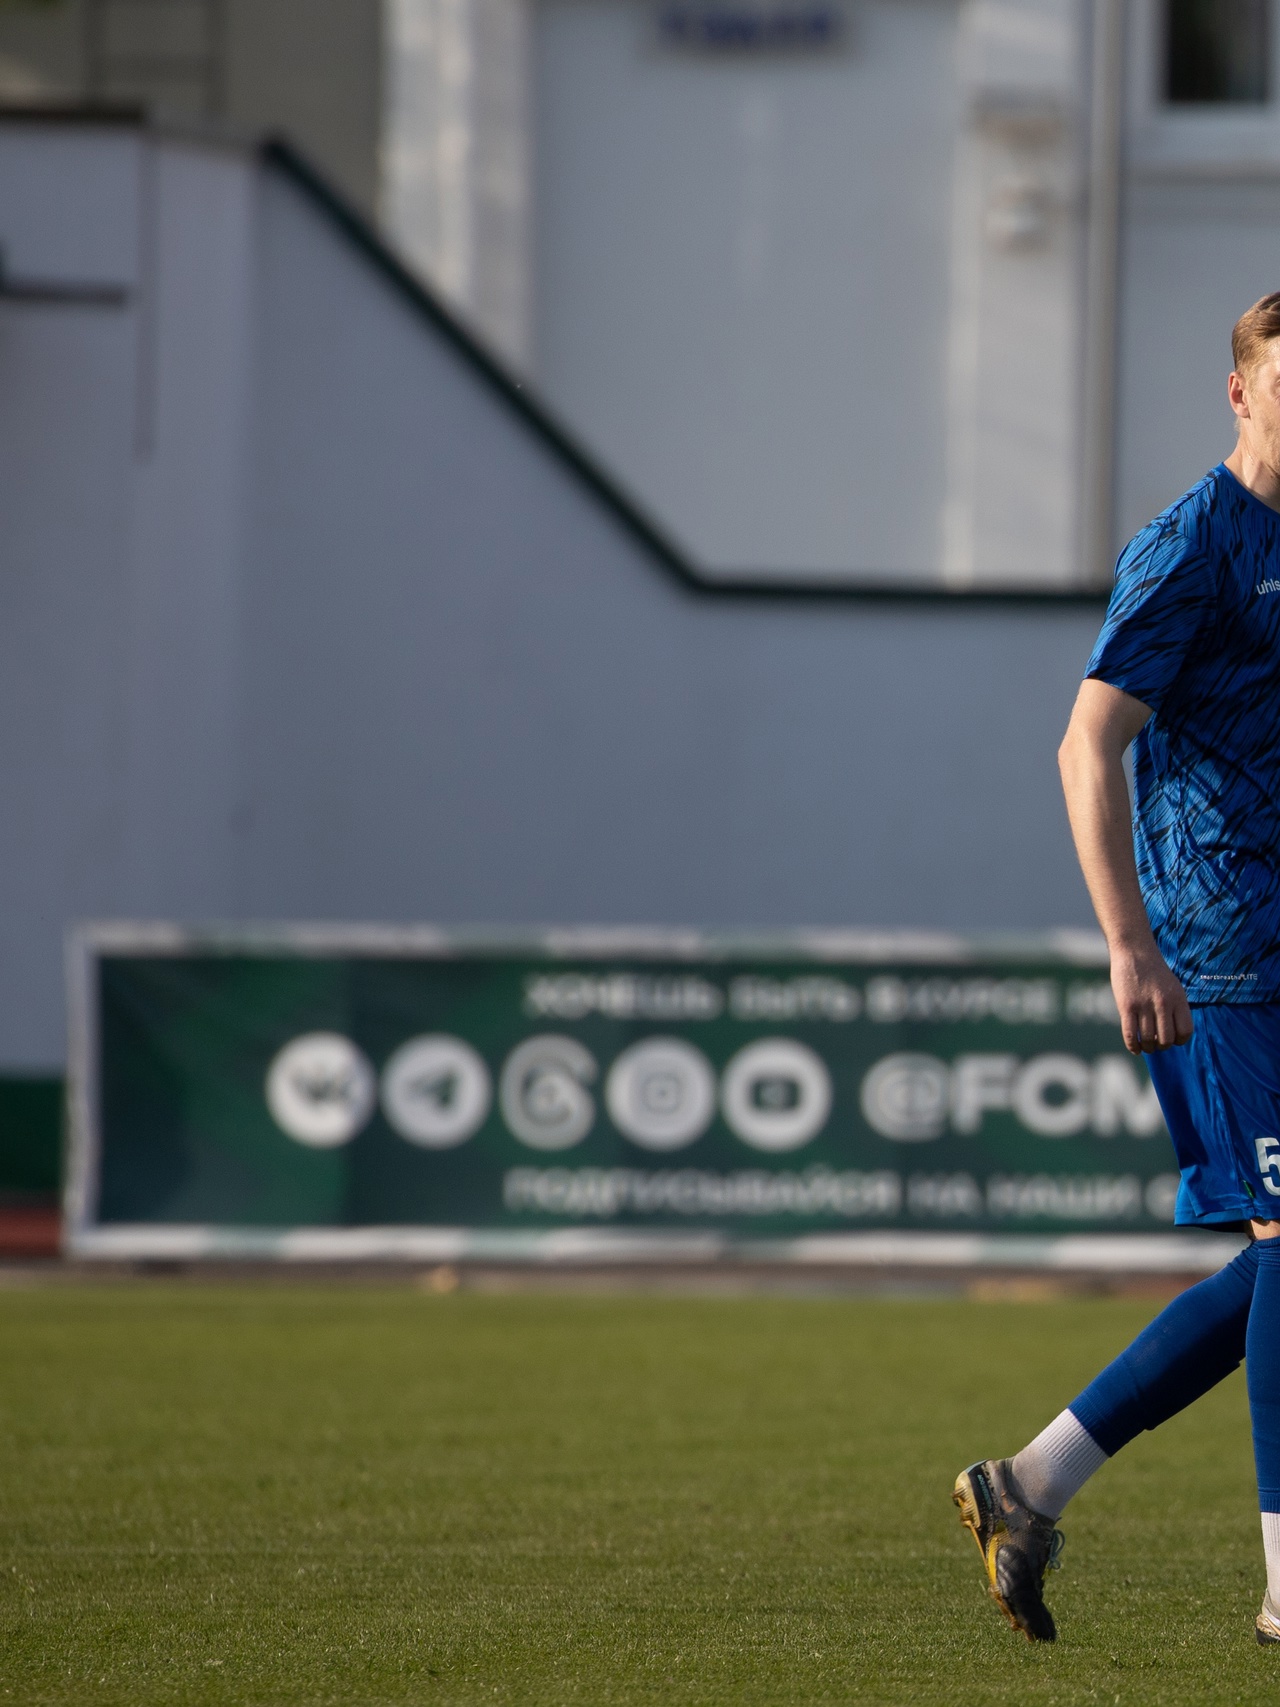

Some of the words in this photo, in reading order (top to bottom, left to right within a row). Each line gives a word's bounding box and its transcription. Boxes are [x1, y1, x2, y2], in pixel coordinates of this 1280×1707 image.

[527, 975, 721, 1016] ХОЧЕШЬ
[731, 977, 857, 1019] БЫТЬ
[906, 979, 1055, 1022] КУРСЕ
[505, 1165, 897, 1213] ПОДПИСЫВАЙСЯ
[908, 1172, 979, 1214] НА
[988, 1173, 1137, 1217] НАШИ
